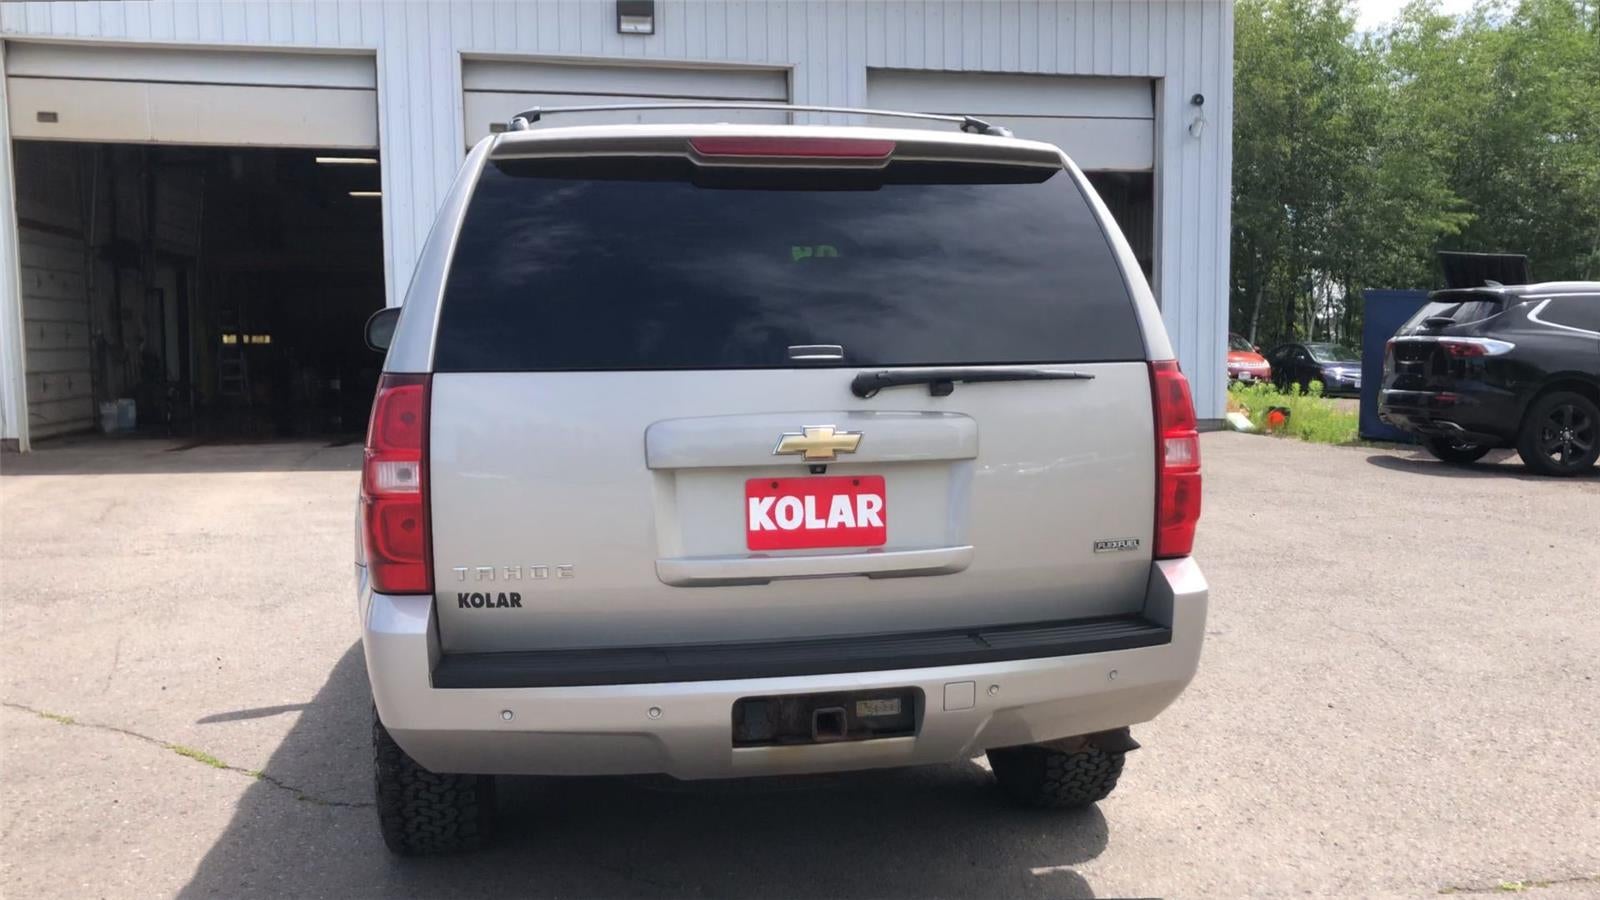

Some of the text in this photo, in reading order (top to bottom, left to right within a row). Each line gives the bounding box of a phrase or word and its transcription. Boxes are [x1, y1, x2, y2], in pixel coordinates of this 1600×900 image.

[749, 494, 884, 531] KOLAR
[452, 564, 575, 581] TAHOE
[457, 592, 522, 608] KOLAR
